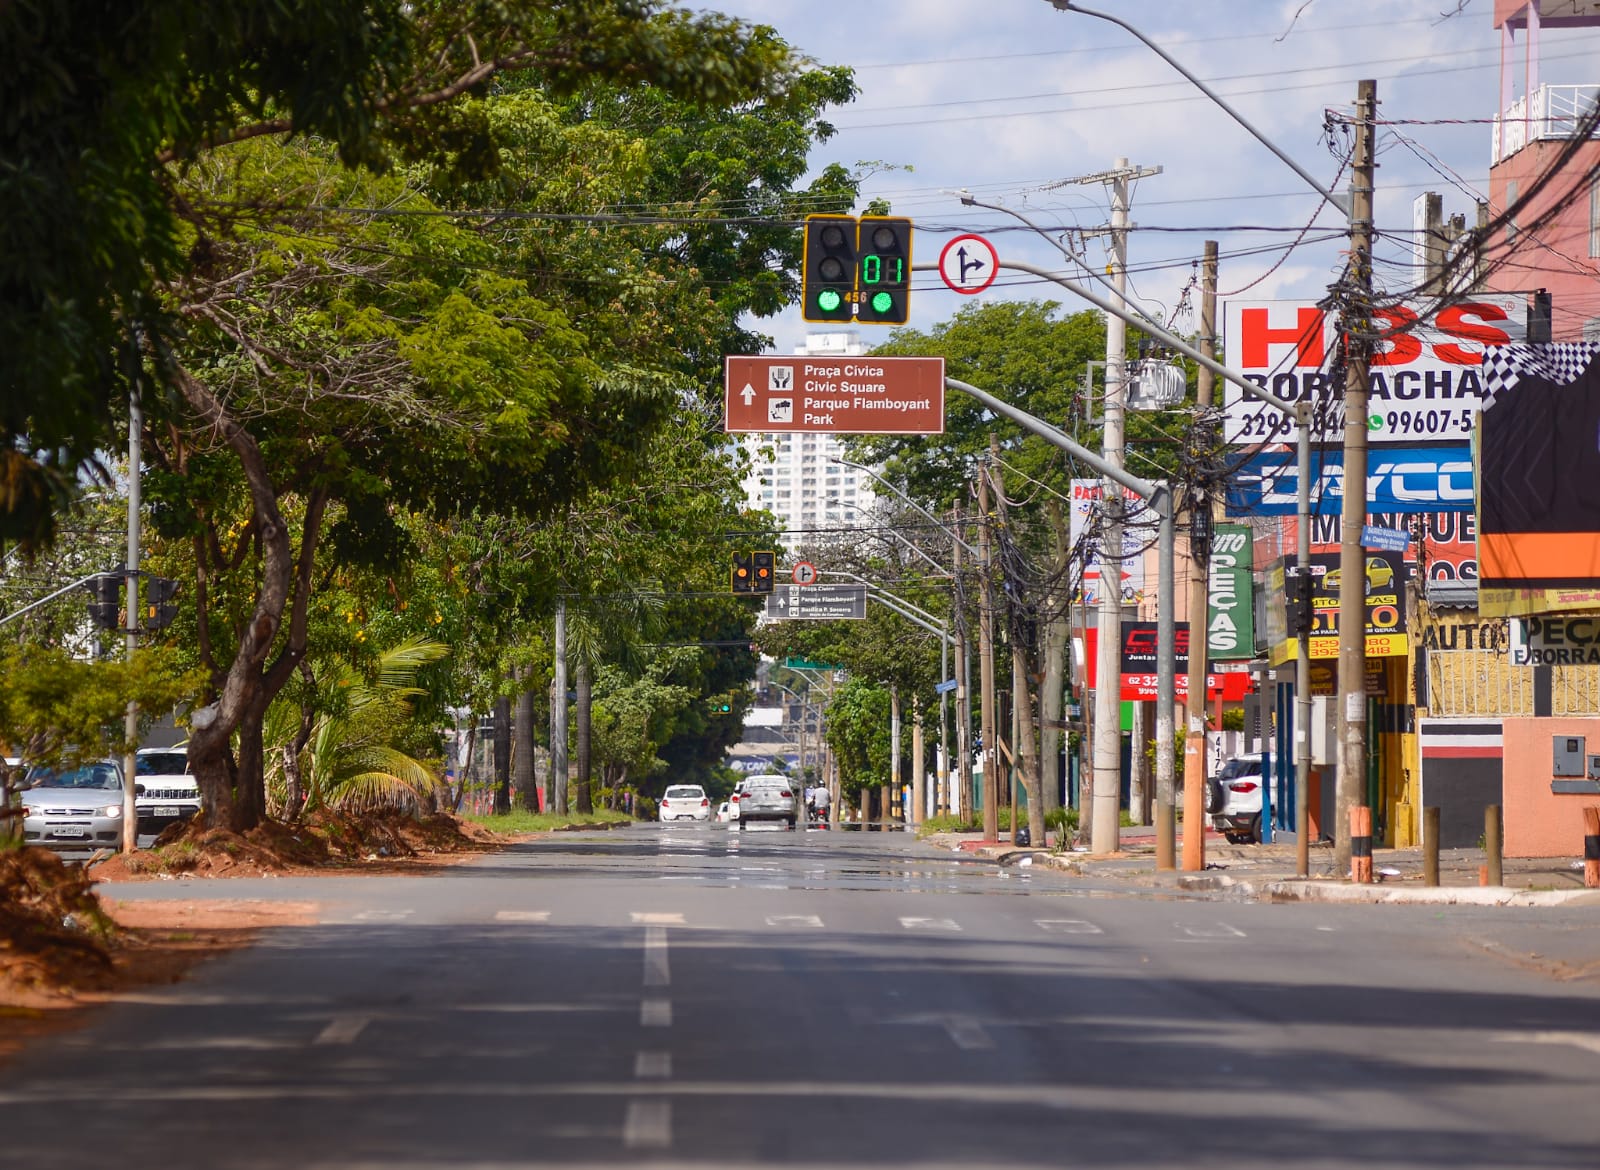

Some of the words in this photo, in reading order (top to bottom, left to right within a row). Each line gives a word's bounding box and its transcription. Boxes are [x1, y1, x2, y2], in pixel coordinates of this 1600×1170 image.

[864, 255, 902, 284] 01
[1242, 303, 1511, 367] HBS
[804, 365, 841, 378] Praça
[805, 381, 837, 392] Civic
[840, 381, 886, 394] Square
[1242, 370, 1481, 402] BORACHA
[804, 398, 850, 411] Parque
[854, 398, 930, 411] Flamboyant
[804, 414, 834, 425] Park
[1208, 554, 1238, 651] PEÇAS
